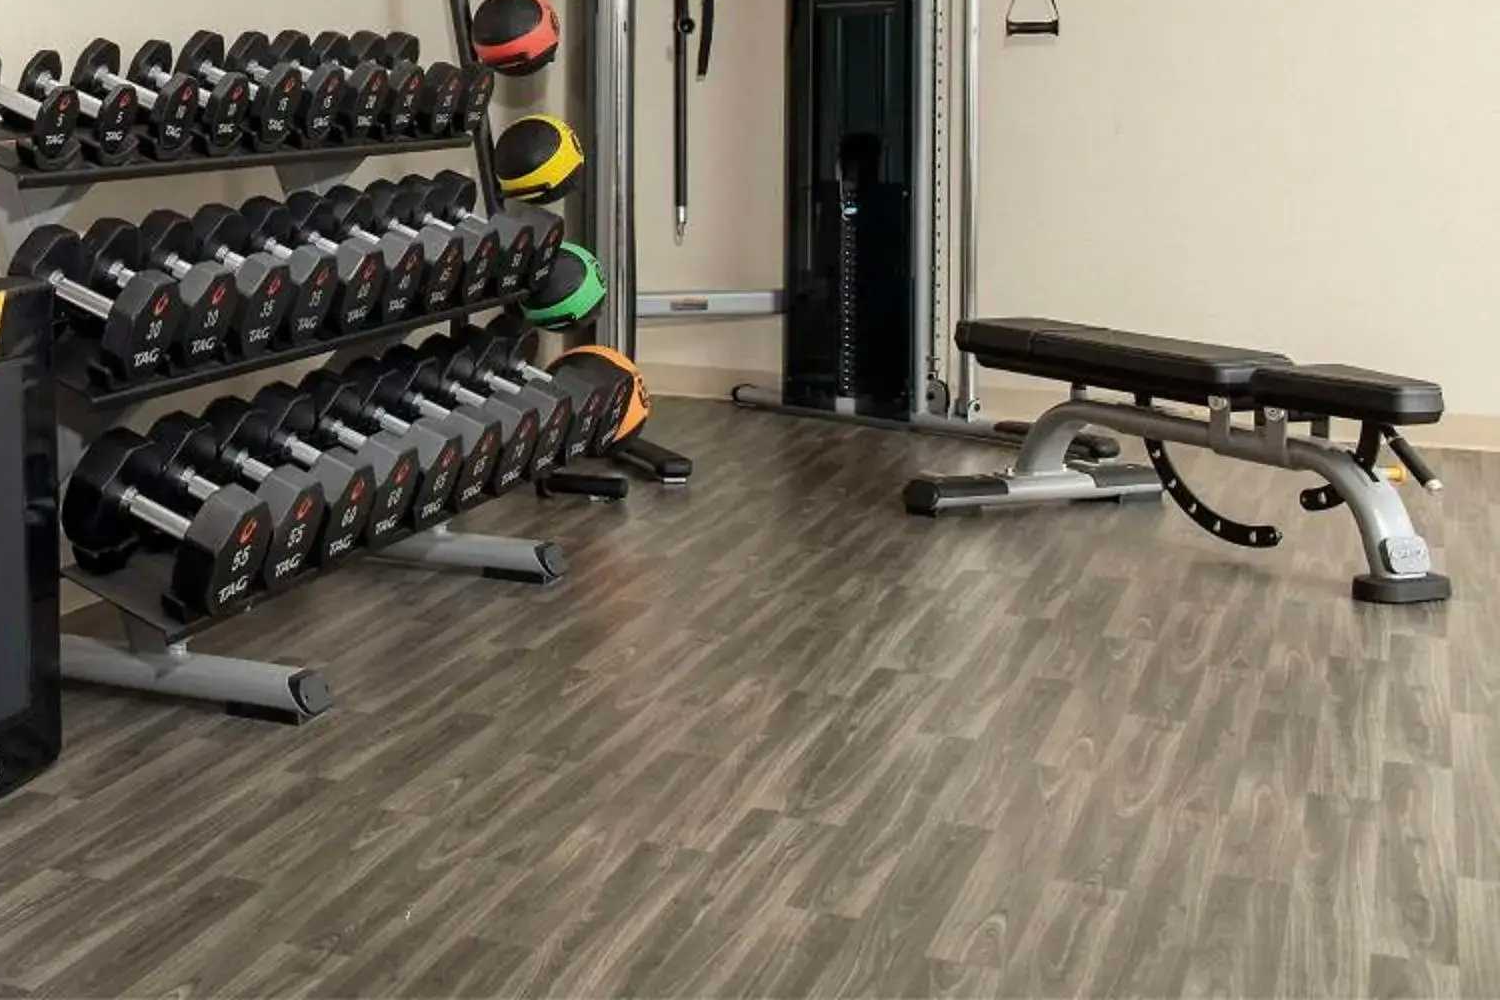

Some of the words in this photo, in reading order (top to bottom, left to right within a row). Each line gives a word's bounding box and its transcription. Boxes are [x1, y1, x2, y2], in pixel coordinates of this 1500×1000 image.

[55, 114, 63, 127] 5
[115, 111, 124, 124] 5
[45, 133, 66, 145] TAG
[105, 130, 124, 142] TAG
[165, 125, 182, 139] TAG
[347, 305, 369, 323] TAG
[388, 297, 407, 312] TAG
[146, 319, 163, 340] 30
[298, 315, 318, 331] TAG
[248, 327, 271, 343] TAG
[191, 336, 217, 355] TAG
[134, 348, 160, 367] TAG
[461, 481, 482, 501] TAG
[421, 498, 443, 519] TAG
[375, 513, 397, 535] TAG
[287, 523, 306, 547] 55
[329, 534, 353, 556] TAG
[231, 545, 251, 571] 55
[275, 553, 301, 577] TAG
[218, 575, 248, 603] TAG
